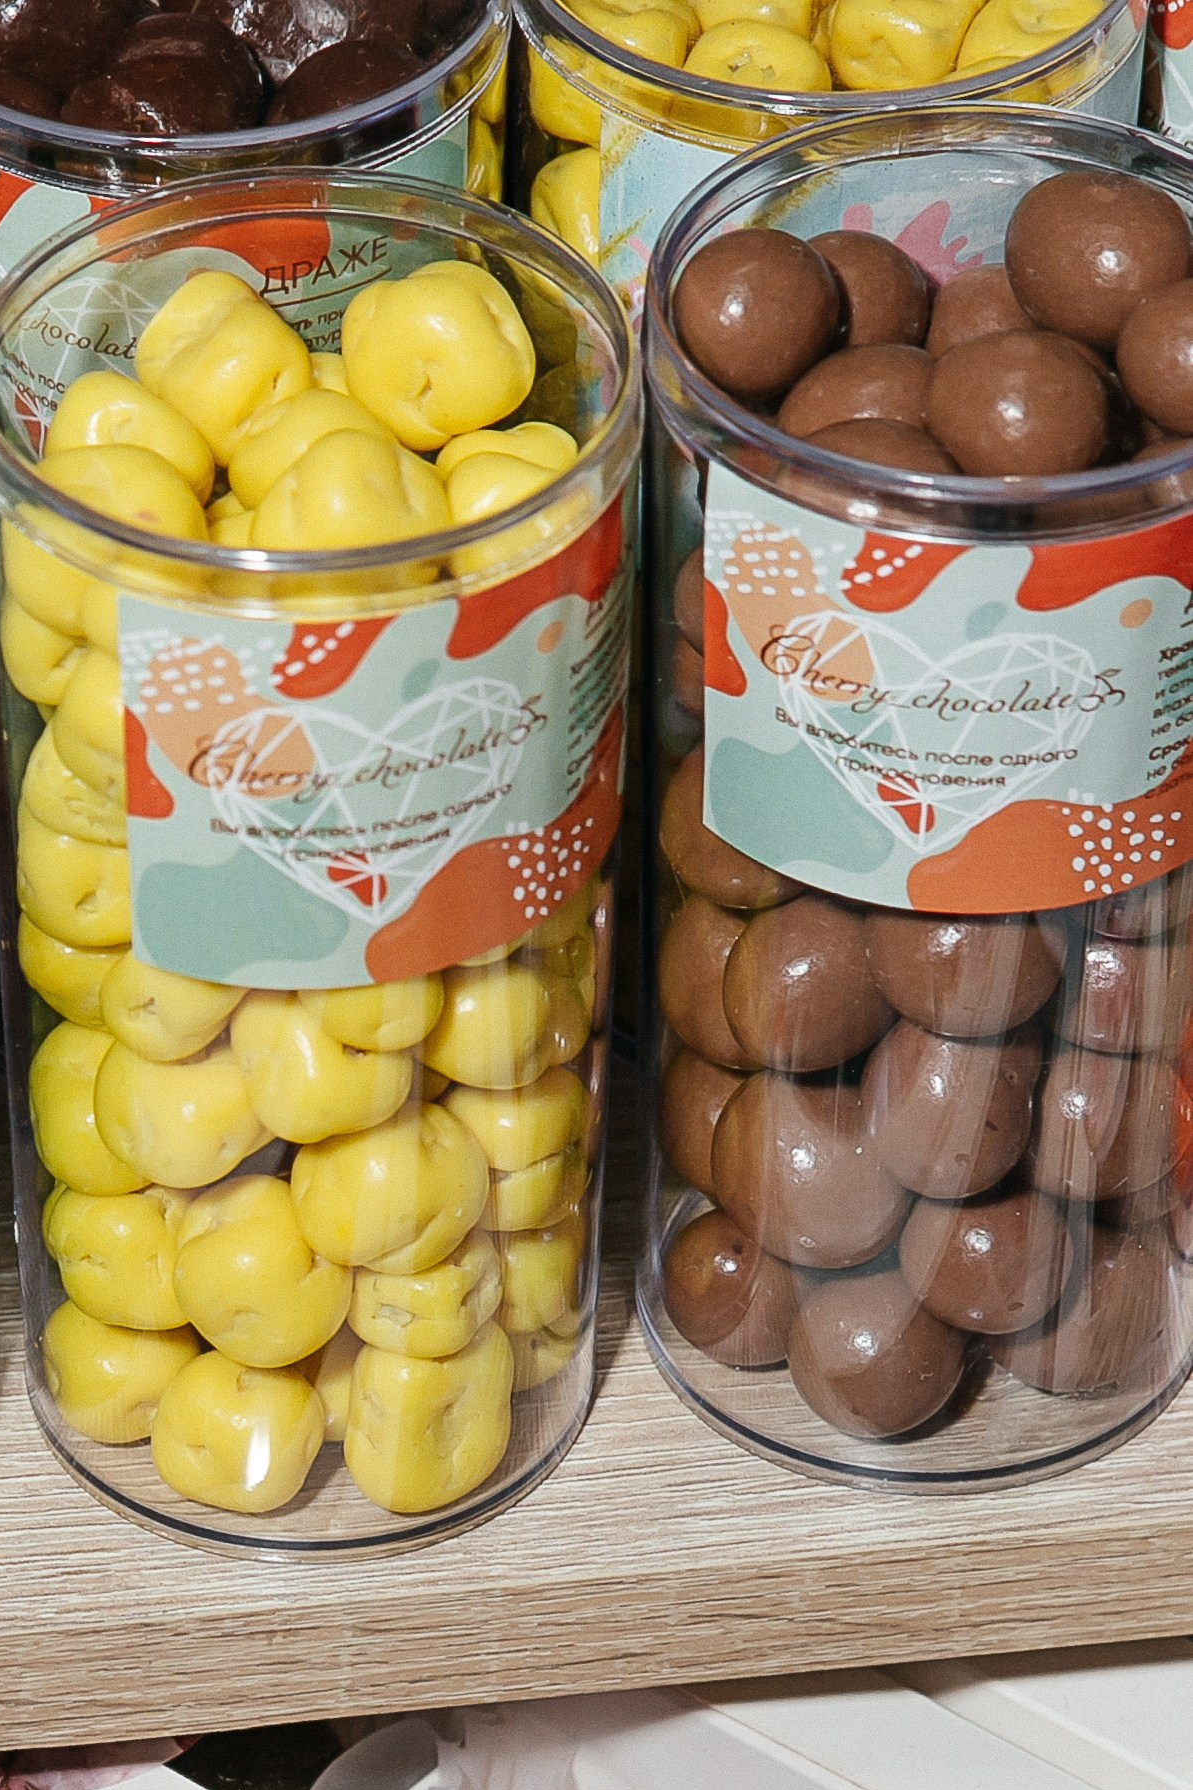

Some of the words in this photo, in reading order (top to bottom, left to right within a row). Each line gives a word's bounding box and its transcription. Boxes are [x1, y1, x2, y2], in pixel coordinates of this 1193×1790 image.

[259, 235, 389, 299] ДРАЖЕ
[38, 373, 65, 394] пос
[775, 706, 800, 729] Вы
[806, 723, 918, 761] влюбитесь
[925, 752, 994, 768] после
[999, 748, 1078, 768] одного
[1149, 734, 1191, 760] Срок
[835, 756, 1006, 788] прикосновения
[372, 811, 438, 833] после
